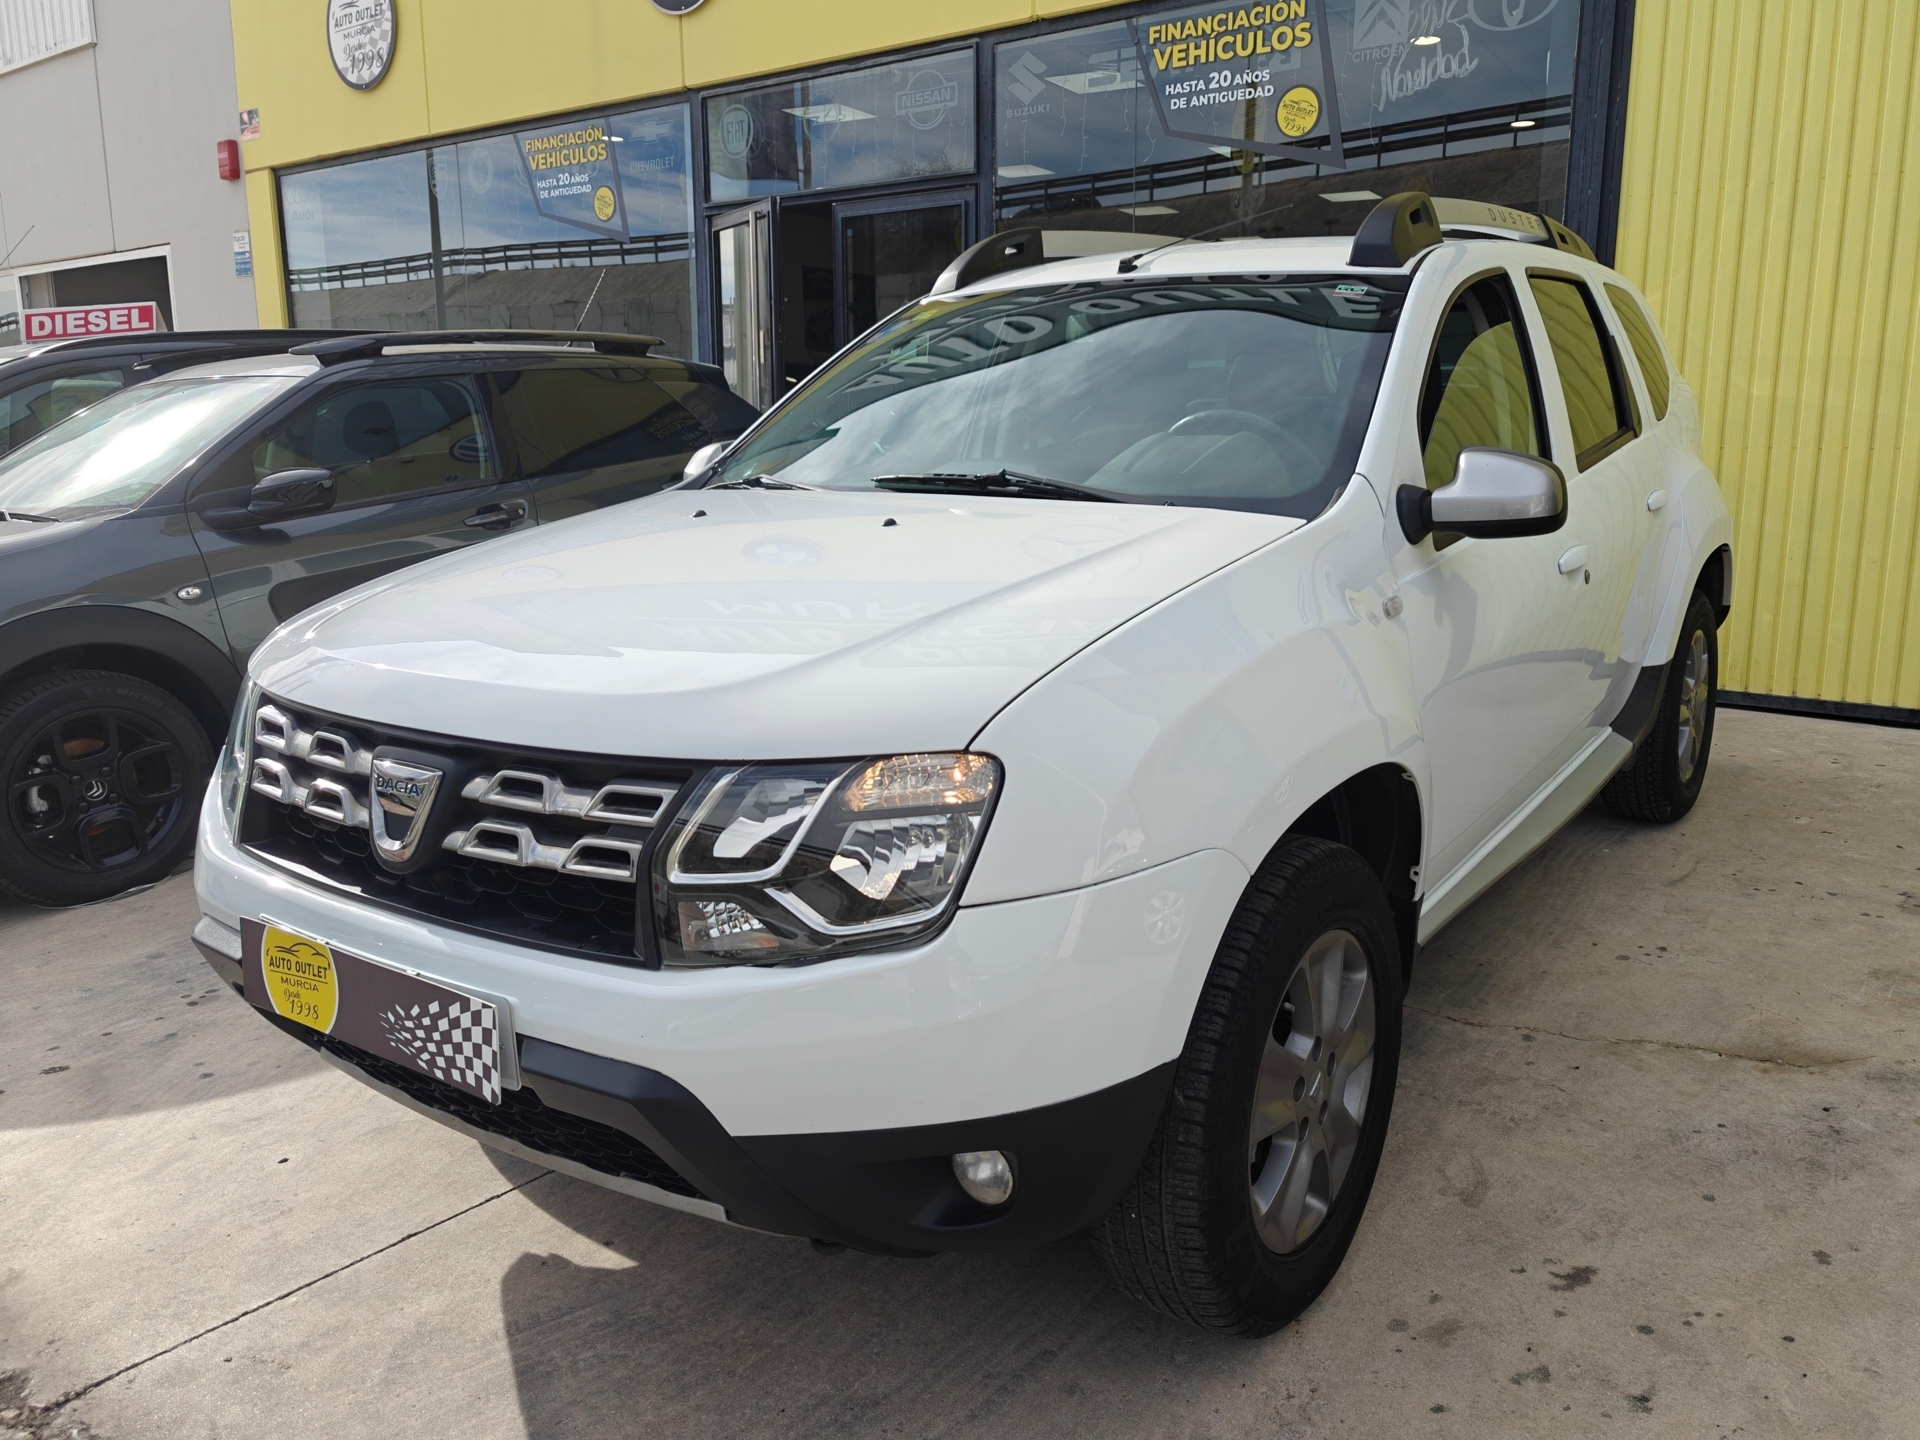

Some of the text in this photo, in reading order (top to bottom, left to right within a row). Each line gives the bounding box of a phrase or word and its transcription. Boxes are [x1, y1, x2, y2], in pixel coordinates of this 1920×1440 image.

[334, 3, 383, 29] AUTO OUTLET
[1148, 0, 1307, 45] FINANCIACIÓN
[343, 25, 375, 40] MURCIA
[1152, 22, 1313, 70] VEHÍCULOS
[350, 47, 385, 74] 1998
[1165, 69, 1271, 96] HASTA 20 AÑOS
[901, 87, 950, 108] NISSAN
[1170, 85, 1275, 110] DE ANTIGUEDAD
[1283, 103, 1314, 116] AUTO OUTLET
[1006, 103, 1050, 118] SUZUKI
[525, 125, 603, 152] FINANCIACIÓN
[726, 120, 745, 145] FIAT
[528, 143, 608, 171] VEHÍCULOS
[629, 156, 675, 173] CHEVROLET
[537, 172, 589, 188] HASTA 20 AÑOS
[540, 184, 592, 199] DE ANTIGUEDAD
[1487, 207, 1543, 232] DUSTER
[31, 308, 150, 337] DIESEL
[377, 774, 420, 797] DACIA
[268, 955, 328, 980] AUTO OUTLET
[280, 976, 320, 993] MURCIA
[289, 999, 319, 1020] 1998
